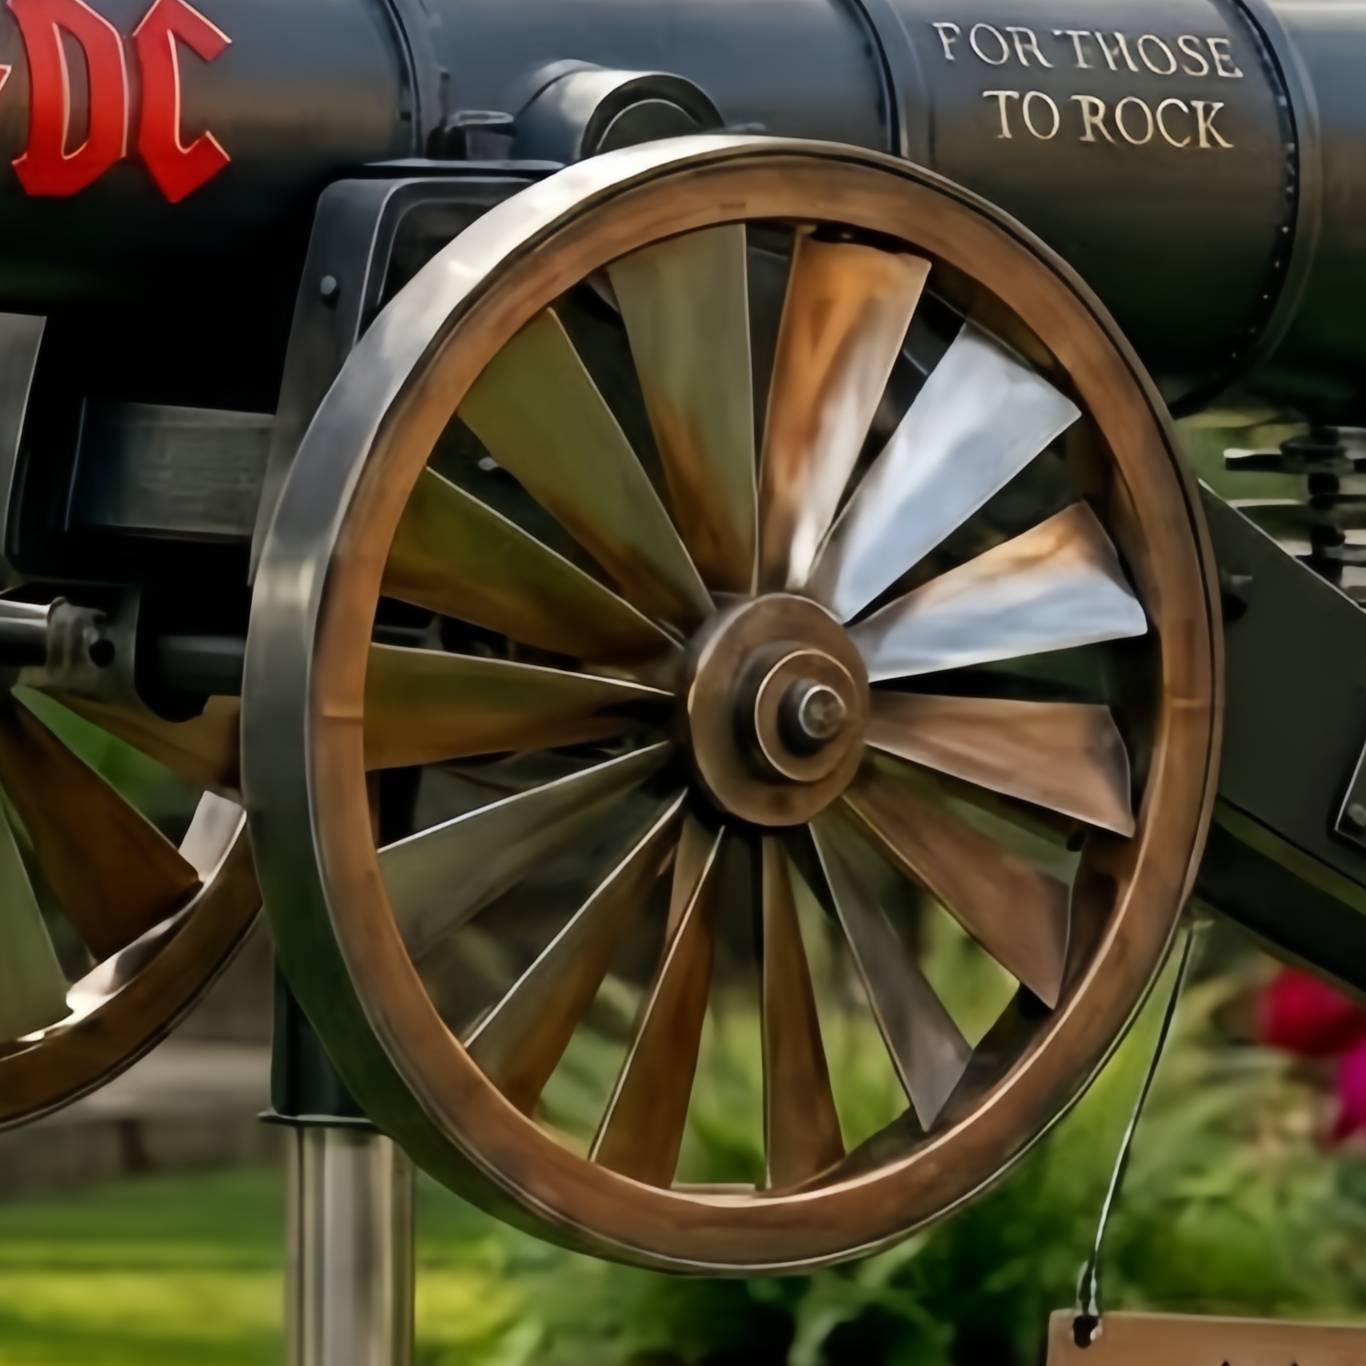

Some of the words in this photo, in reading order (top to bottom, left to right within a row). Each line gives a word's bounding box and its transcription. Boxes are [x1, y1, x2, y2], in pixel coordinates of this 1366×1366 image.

[1052, 28, 1244, 78] THOSE
[981, 88, 1061, 141] TO
[1069, 93, 1235, 150] ROCK
